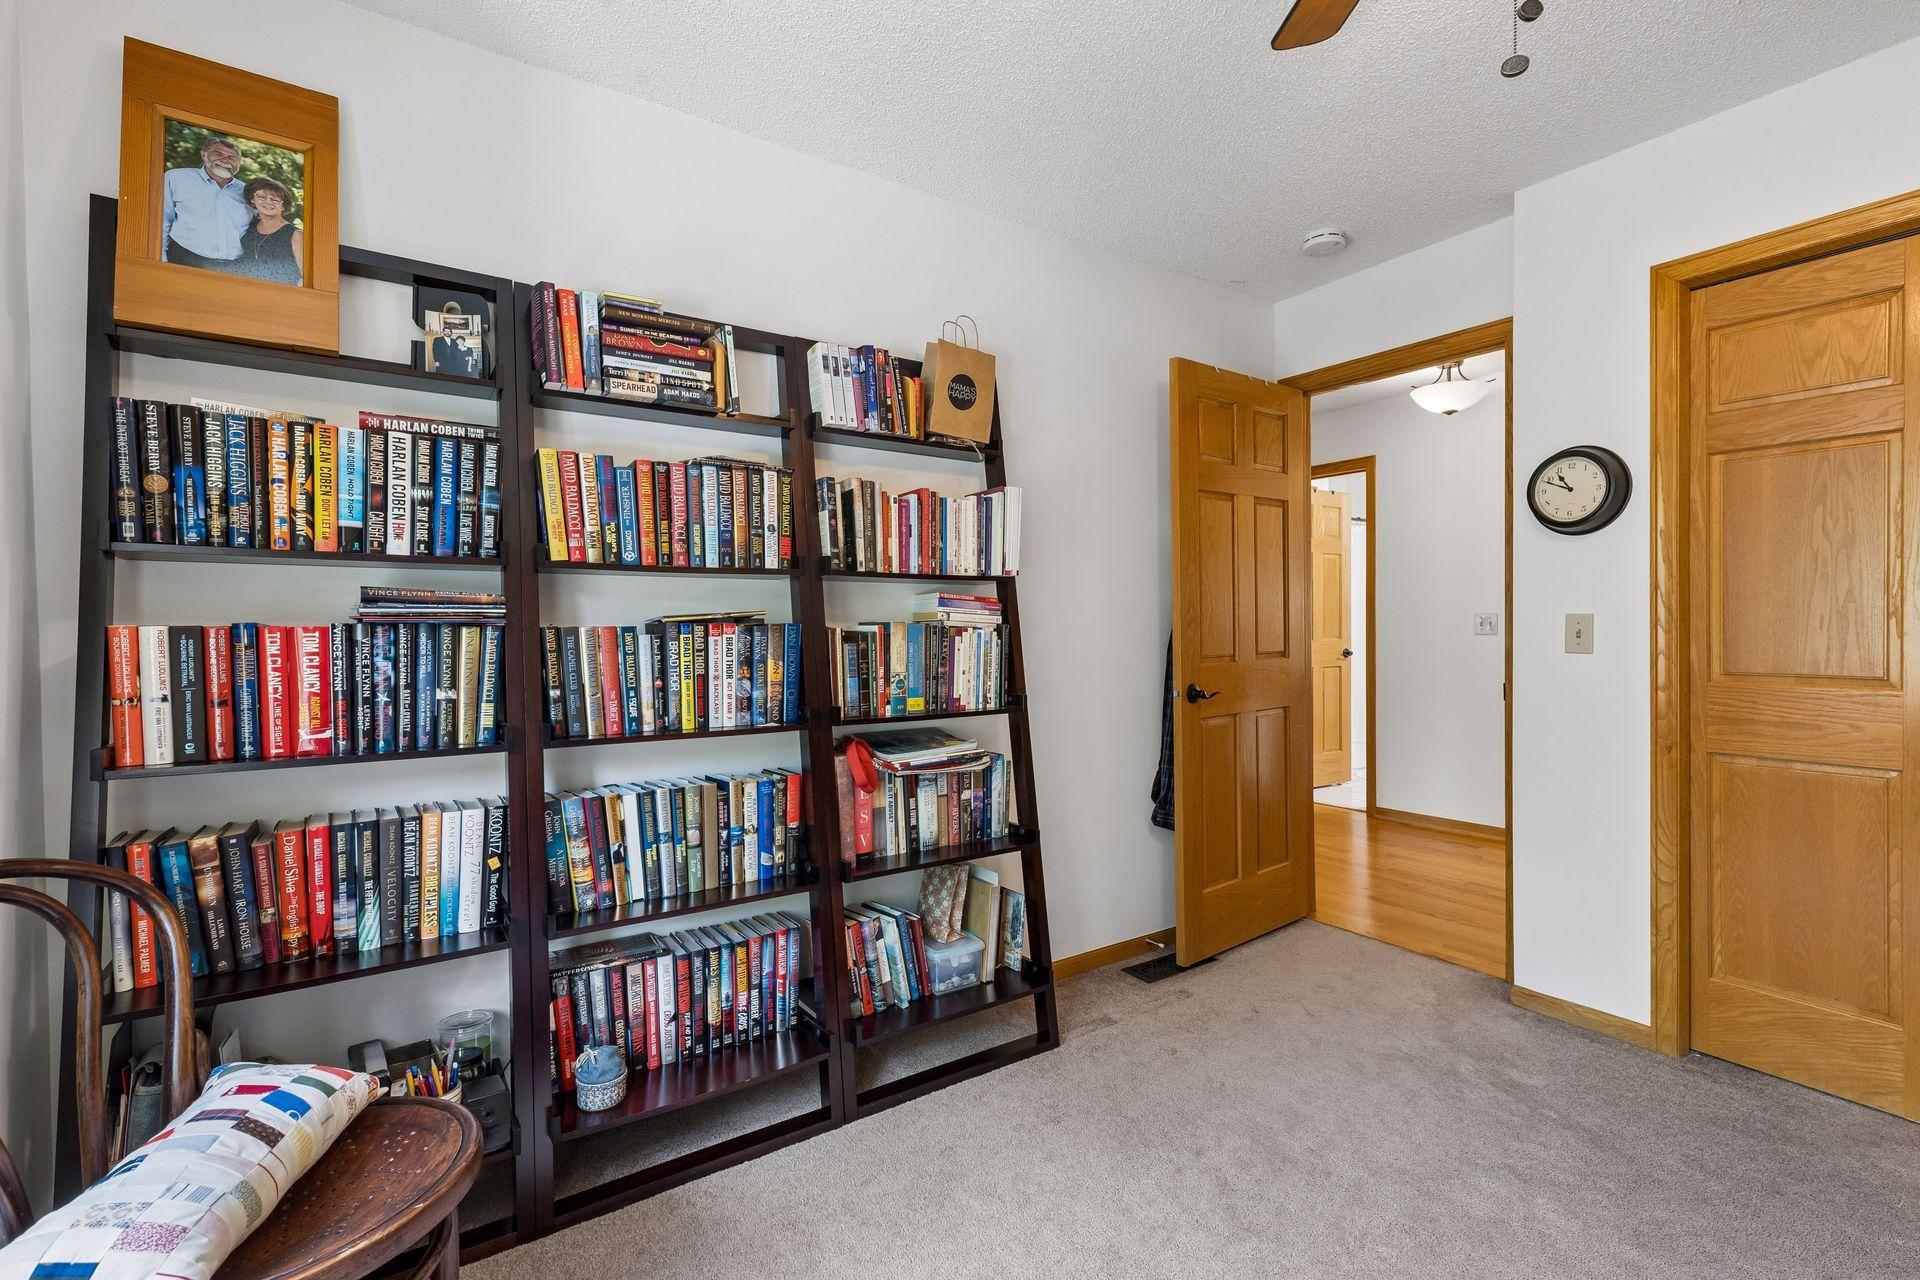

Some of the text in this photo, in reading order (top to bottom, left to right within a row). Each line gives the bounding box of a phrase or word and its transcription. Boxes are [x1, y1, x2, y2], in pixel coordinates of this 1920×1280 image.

[632, 312, 657, 322] MORNING
[606, 336, 644, 350] BROWN
[612, 381, 700, 399] SPEARHEAD ADAM MAKOS
[949, 390, 977, 404] HAPPY
[950, 382, 977, 396] MAMA'S
[146, 404, 160, 474] STEVE BERRY
[183, 416, 193, 468] STEVE BERRY
[384, 418, 466, 438] HARLAN COBEN
[116, 408, 130, 484] THE PATRIOT THREAT
[206, 418, 222, 488] JACK HIGGINS
[228, 416, 247, 496] JACK HIGGINS
[319, 428, 331, 463] HARLAN
[392, 436, 406, 480] HARLAN
[441, 441, 453, 474] HARLAN
[272, 437, 289, 517] HARLAN COBEN
[294, 426, 306, 536] HARLAN COBEN RUN AWAY
[320, 466, 332, 496] COBEN
[347, 456, 355, 476] COBEN
[392, 484, 408, 520] COBEN
[440, 476, 452, 505] COBEN
[563, 454, 582, 530] DAVID BALDACCI
[622, 486, 631, 519] FINISHER
[672, 466, 686, 539] DAVID BALDACCI
[230, 504, 240, 528] MERCY
[240, 502, 250, 534] WITHOUT
[322, 498, 330, 517] DON'T
[322, 518, 330, 528] LET
[370, 511, 384, 542] CAUGHT
[416, 506, 430, 542] STAY CLOSE
[460, 513, 472, 543] LIVE WIRE
[484, 515, 494, 548] MISSING YOU
[610, 522, 616, 532] NO
[368, 588, 398, 596] VINCE
[401, 590, 431, 598] FLYNN
[268, 632, 280, 654] TOM
[302, 631, 319, 655] TOM
[334, 627, 342, 658] VINCE
[683, 636, 691, 658] BRAD
[726, 636, 734, 658] BRAD
[303, 656, 320, 693] CLANCY
[334, 660, 342, 691] FLYNN
[362, 638, 370, 697] VINCE FLYNN
[568, 650, 576, 672] CAMEL
[669, 641, 680, 691] BRAD THOR
[726, 659, 734, 680] THOR
[268, 657, 282, 699] CLANCY
[310, 696, 320, 718] AGAINST
[610, 701, 618, 722] TARGET
[630, 698, 638, 718] ESCAPE
[274, 726, 282, 746] SIGHT
[310, 720, 320, 730] ALL
[283, 836, 297, 868] Daniel
[488, 812, 503, 912] KOONTZ The Good Guy
[285, 868, 299, 894] Silva
[425, 836, 438, 928] KOONTZ BREATHLESS
[549, 858, 557, 881] MERCY
[229, 848, 252, 950] JOHN HART IRON HOUSE
[387, 870, 397, 922] VELOCITY
[287, 904, 300, 932] English
[138, 920, 148, 948] MICHAEL
[288, 934, 300, 948] Spy
[140, 950, 150, 974] PALMER
[750, 988, 760, 1019] MURDER
[615, 1019, 624, 1038] CROSS
